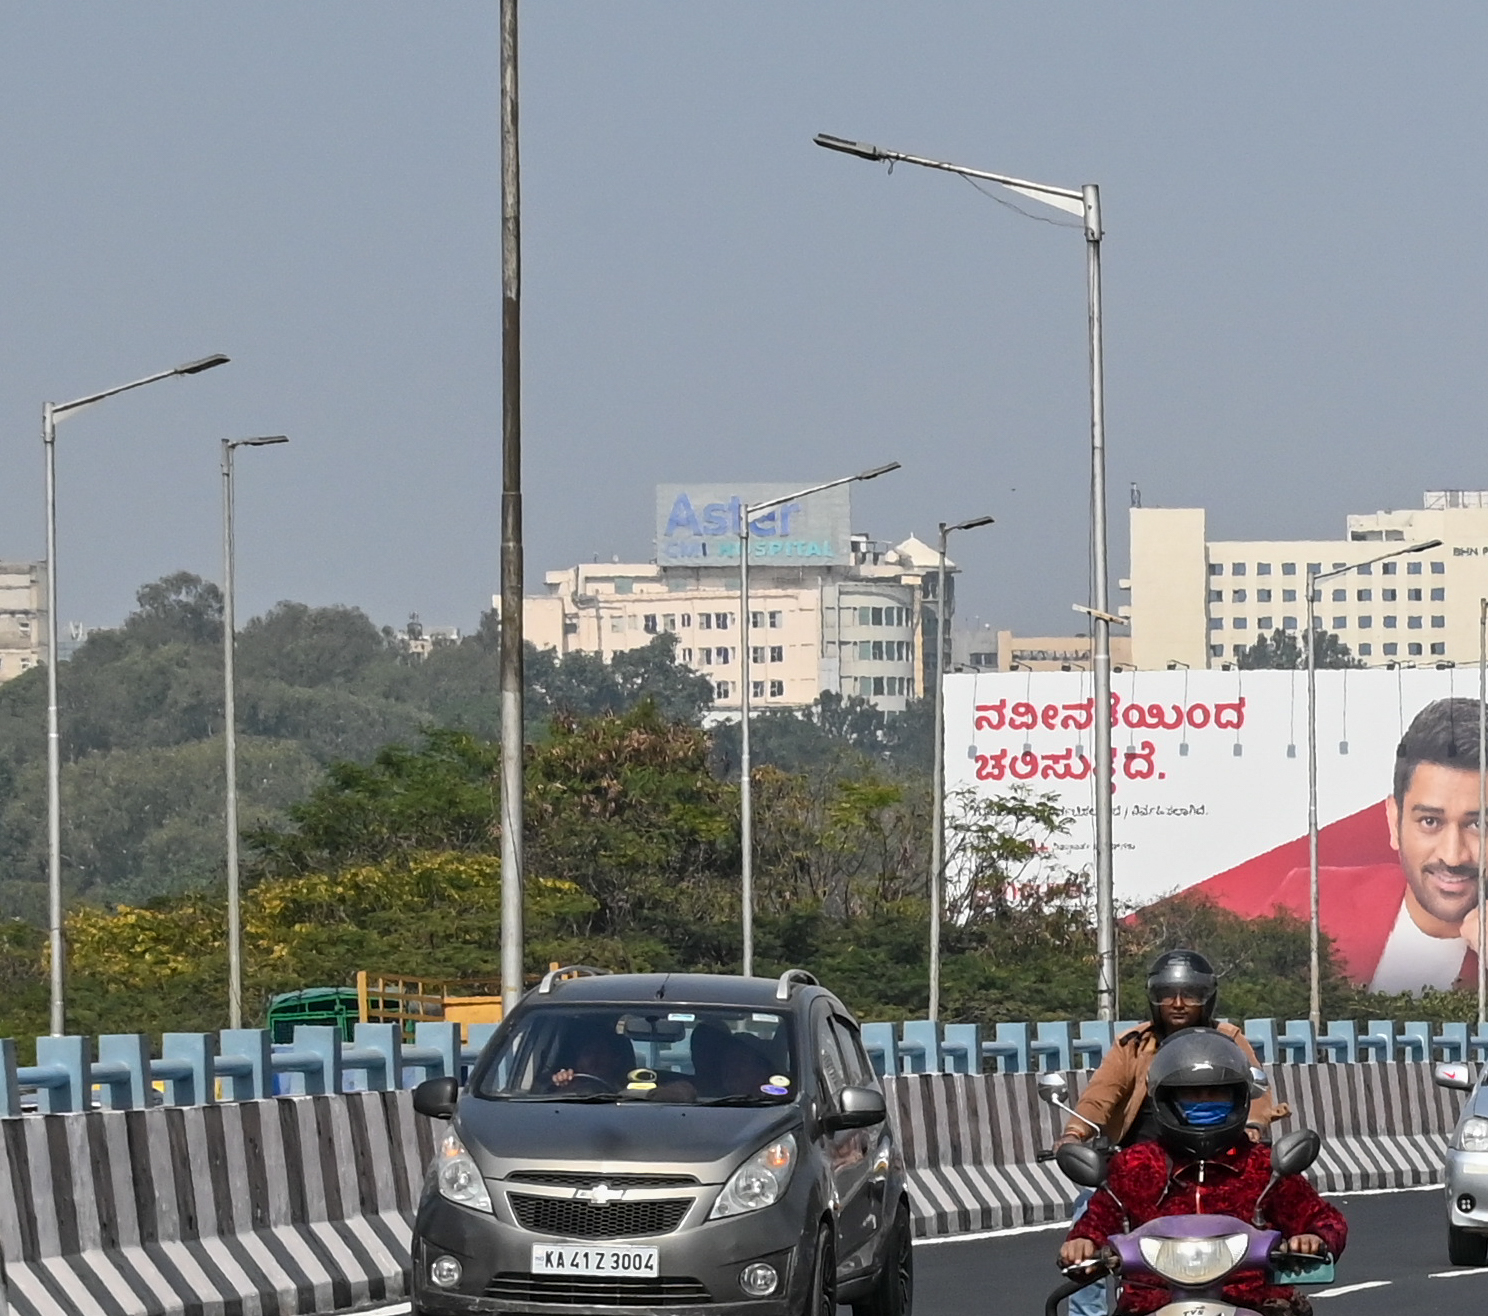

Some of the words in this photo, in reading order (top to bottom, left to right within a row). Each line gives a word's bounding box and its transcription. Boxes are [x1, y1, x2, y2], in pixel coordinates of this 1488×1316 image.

[718, 540, 834, 558] HSPITAL
[545, 1251, 565, 1268] KA
[570, 1252, 589, 1269] 41
[595, 1253, 605, 1269] Z
[610, 1253, 654, 1271] 3004
